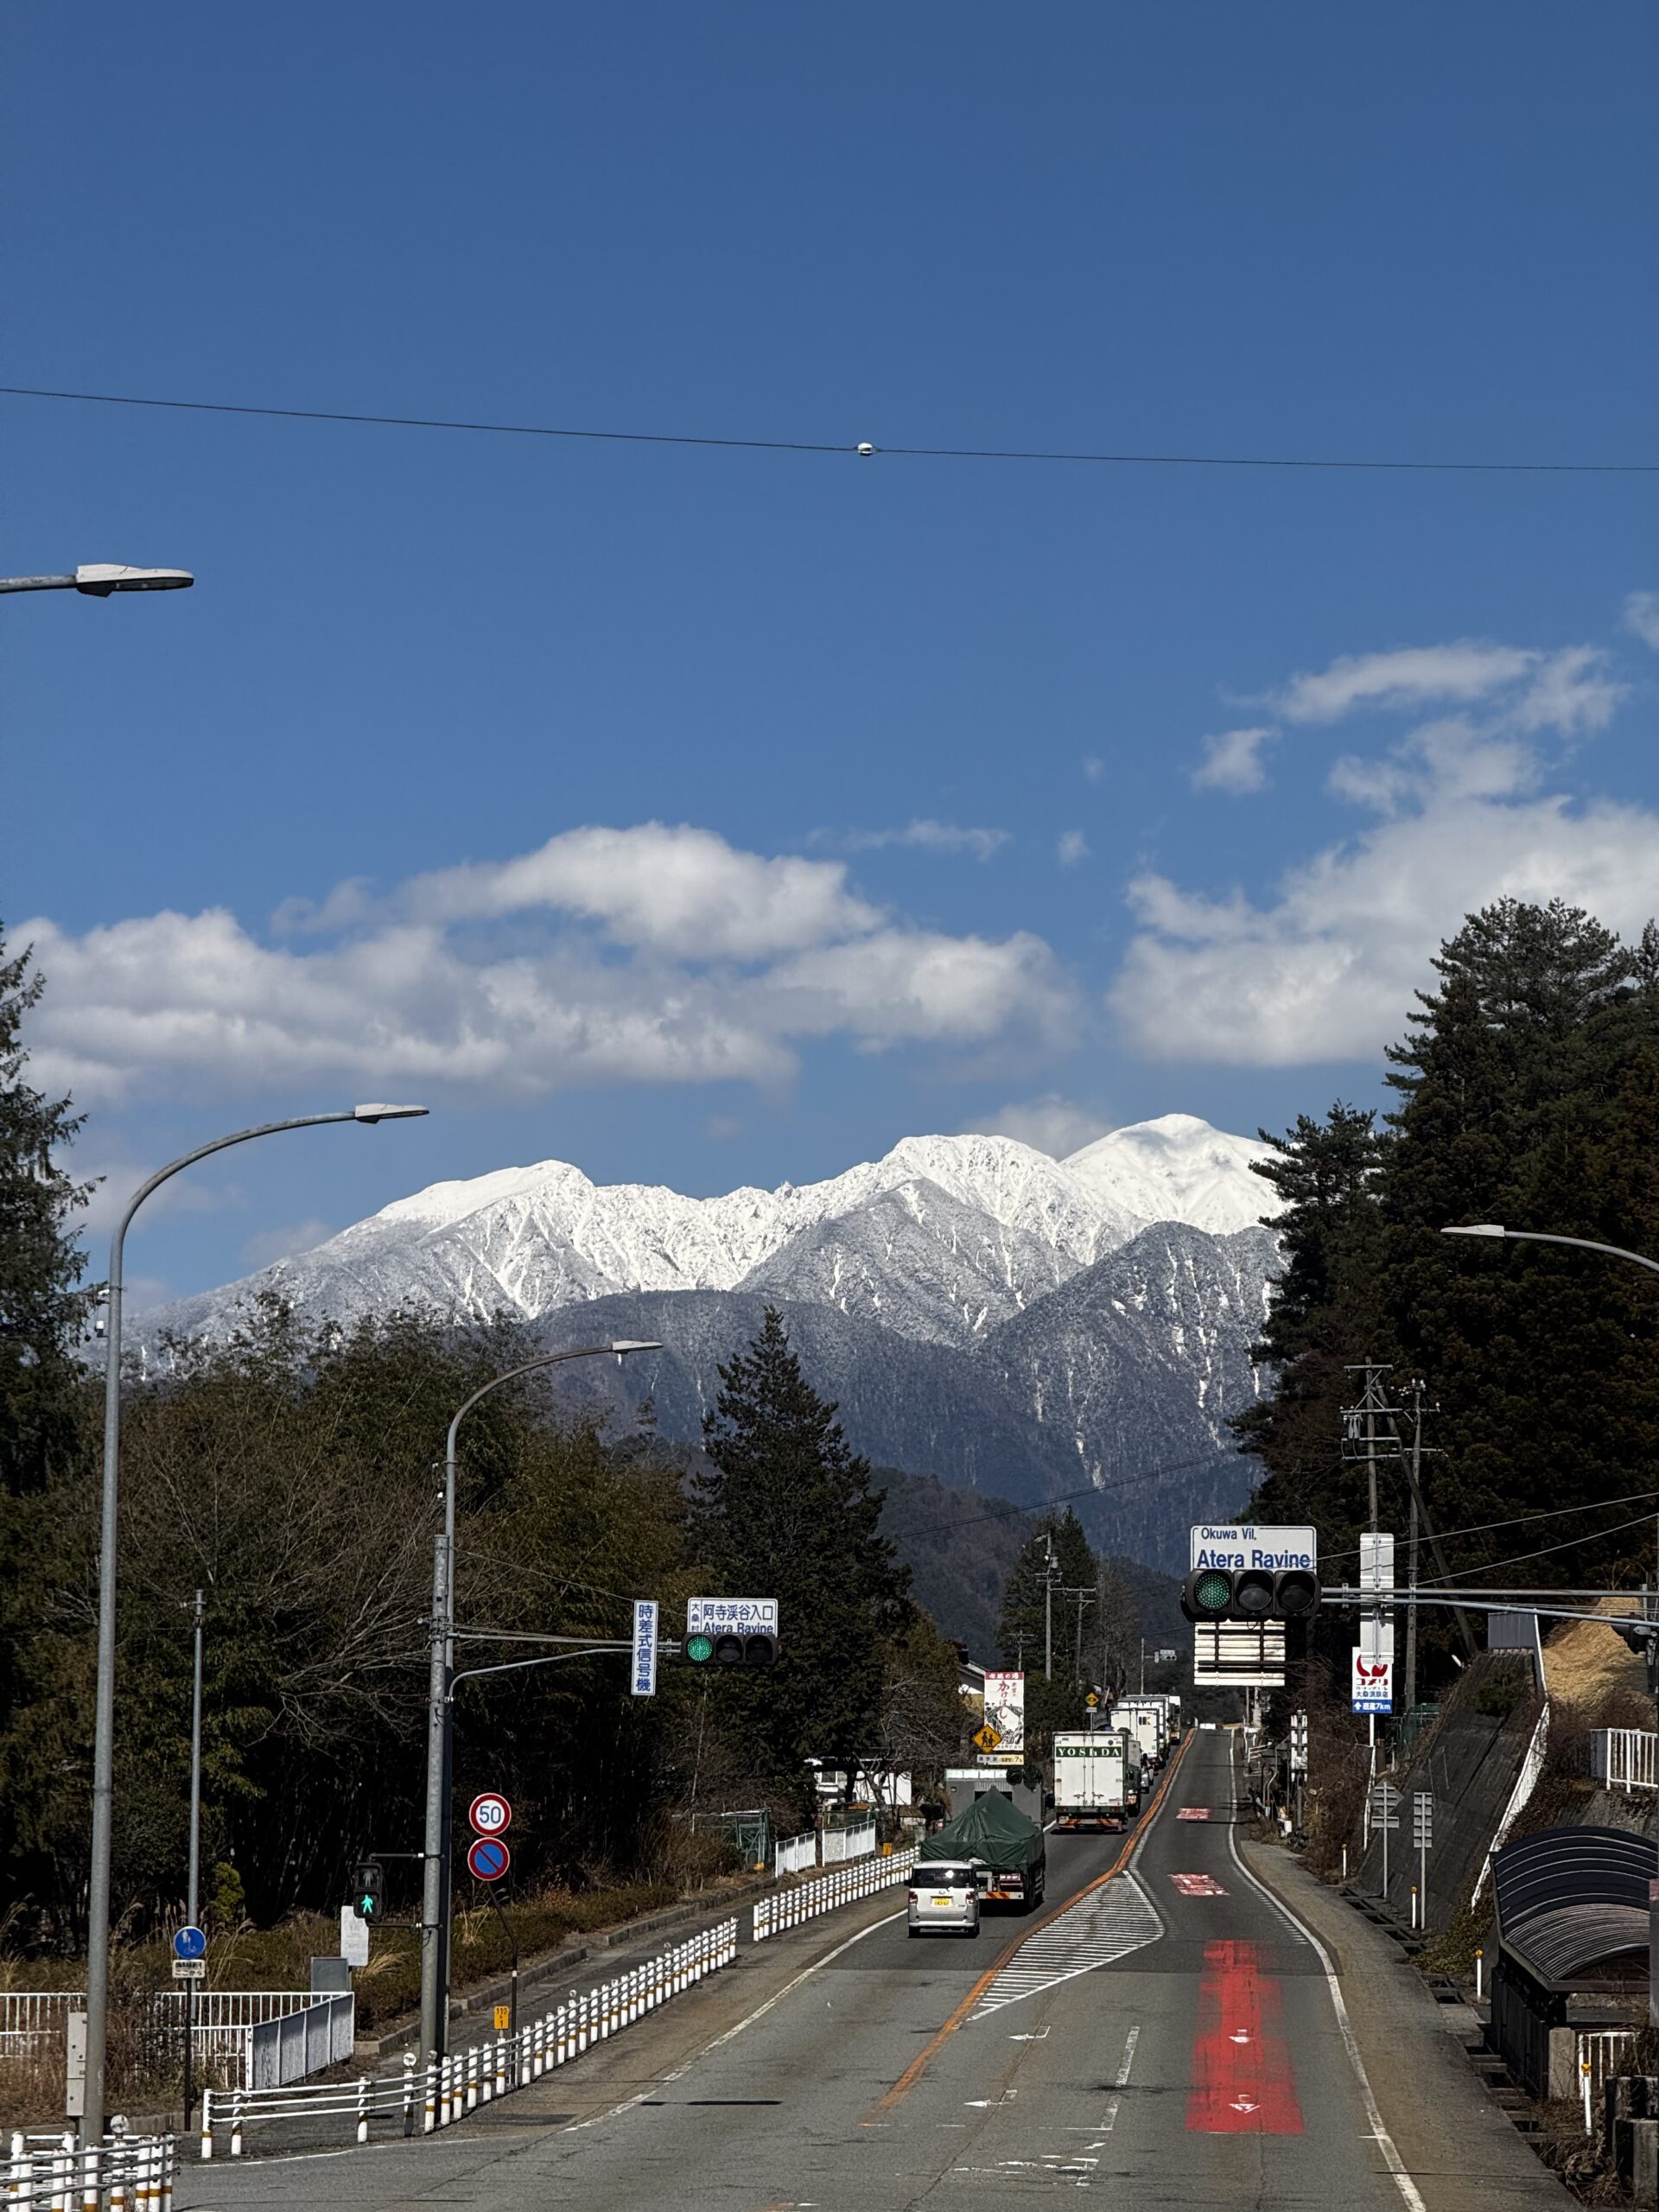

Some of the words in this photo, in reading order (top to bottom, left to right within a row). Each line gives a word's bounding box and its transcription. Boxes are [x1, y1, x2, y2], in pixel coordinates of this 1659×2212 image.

[1201, 1527, 1237, 1540] Okuwa
[1242, 1527, 1256, 1540] Vil.
[1197, 1549, 1244, 1568] Atera
[1251, 1549, 1310, 1568] Ravine
[703, 1604, 773, 1621] 阿寺渓谷入口
[703, 1622, 733, 1633] Atera
[737, 1622, 773, 1633] Ravine
[636, 1604, 654, 1693] 時差式信号機
[997, 1681, 1009, 1719] かけはし
[480, 1806, 501, 1824] 50
